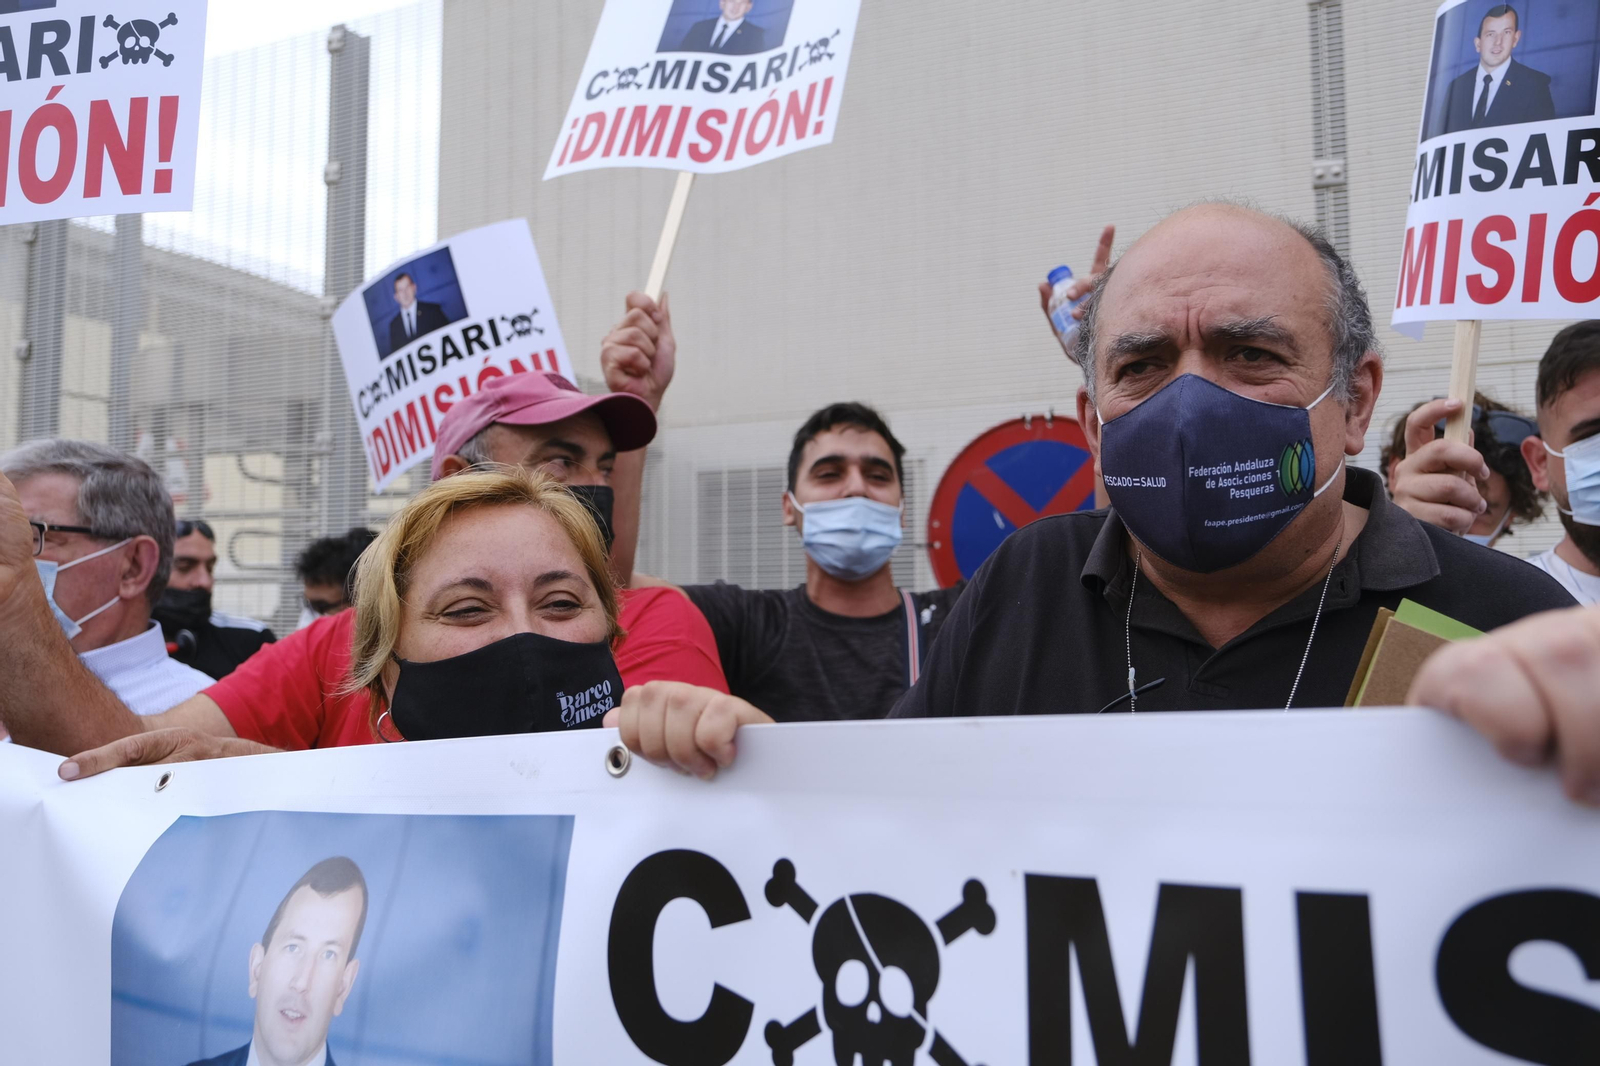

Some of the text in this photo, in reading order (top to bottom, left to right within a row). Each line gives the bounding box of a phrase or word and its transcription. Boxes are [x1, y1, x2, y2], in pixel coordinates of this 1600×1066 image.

[556, 76, 834, 167] ¡DIMISIÓN!
[1188, 457, 1275, 478] Federación Andaluza
[1205, 479, 1216, 489] de
[1230, 483, 1275, 499] Pesqueras
[557, 679, 612, 724] Barco
[575, 696, 615, 724] mesa
